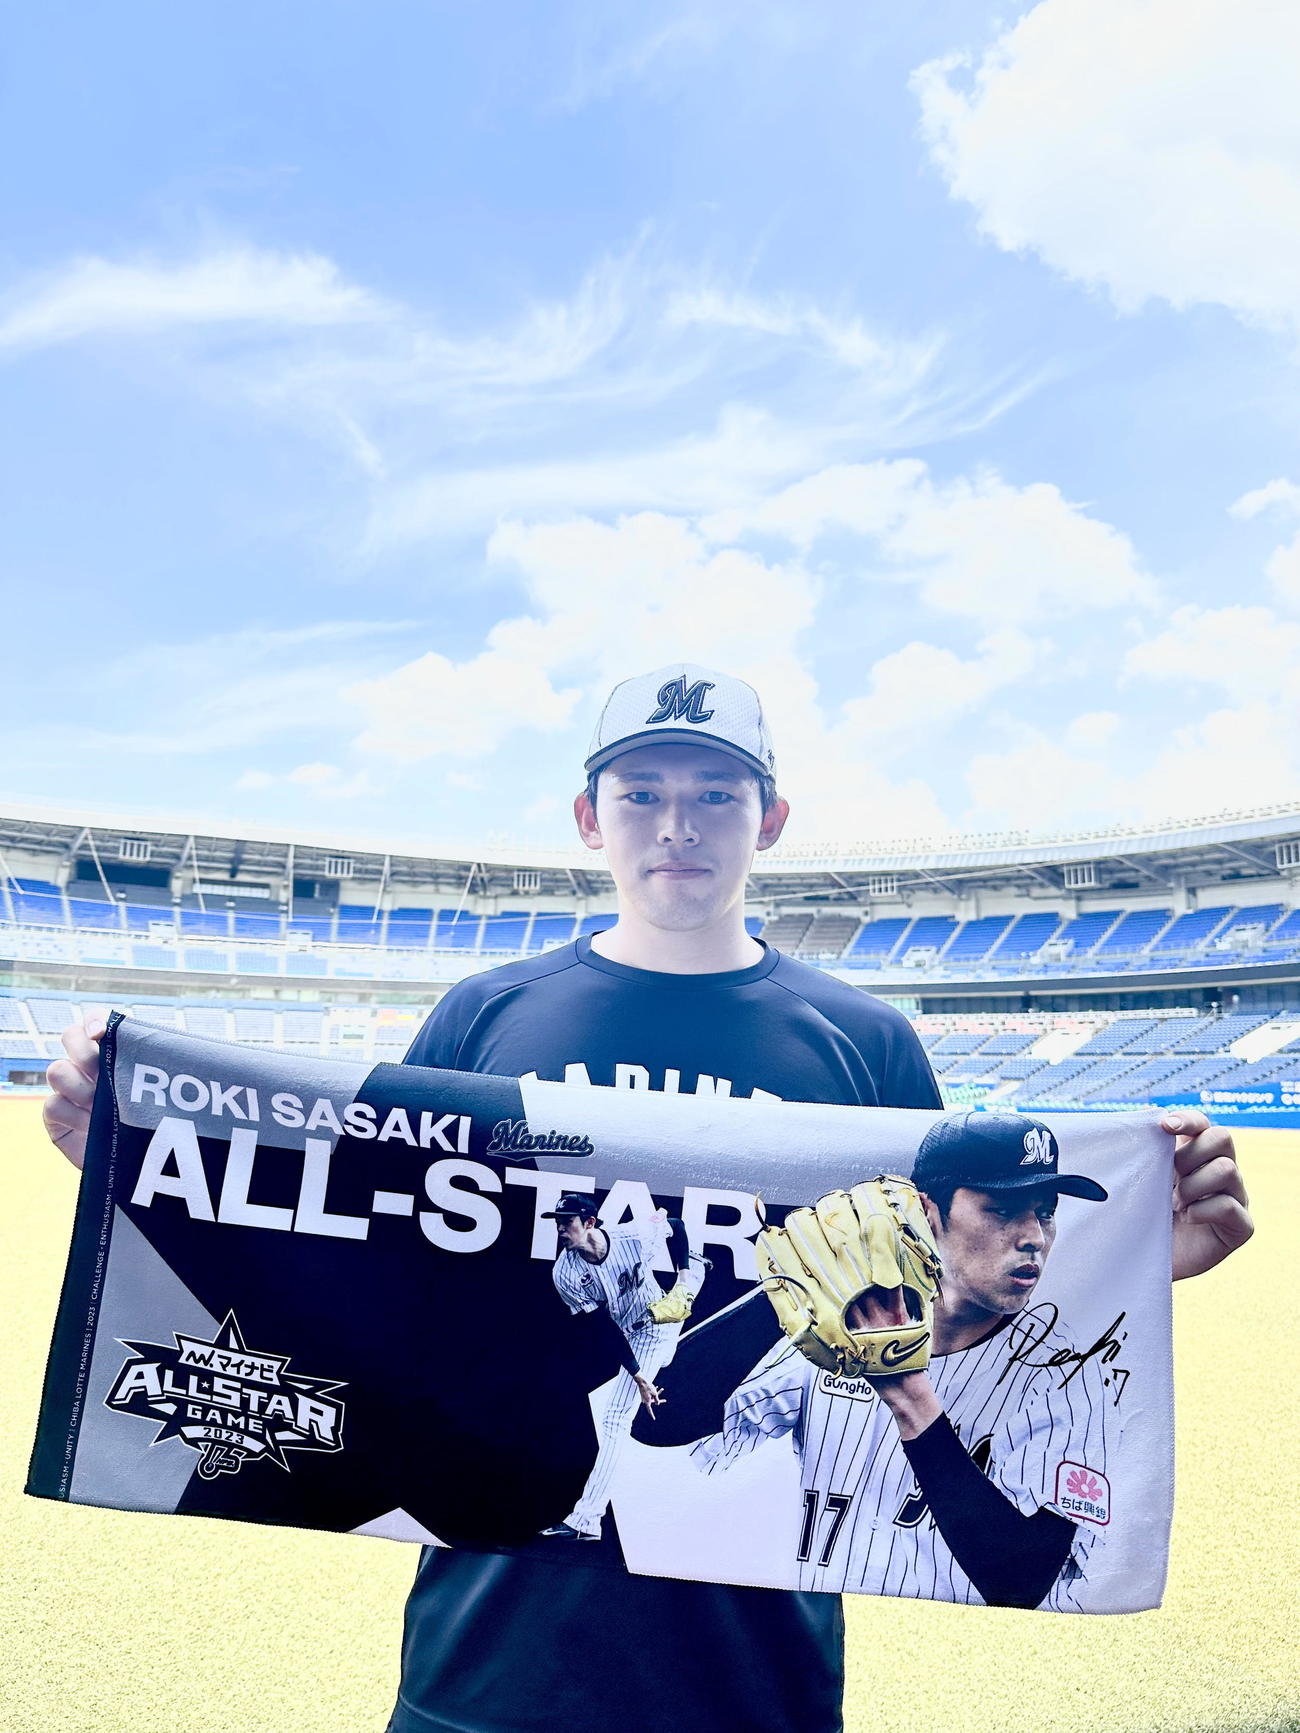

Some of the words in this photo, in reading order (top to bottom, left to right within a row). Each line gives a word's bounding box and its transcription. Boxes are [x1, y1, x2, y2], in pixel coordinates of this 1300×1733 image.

[646, 674, 716, 724] M
[131, 1063, 260, 1122] ROKI
[271, 1092, 472, 1154] SASAKI
[487, 1119, 595, 1160] Marines
[131, 1116, 768, 1282] ALL-STAR
[100, 1193, 111, 1246] ENTHUSIASM
[91, 1250, 104, 1300] CHALLENGE
[87, 1305, 95, 1327] 2023
[80, 1332, 91, 1371] MARINES
[218, 1354, 275, 1382] マイナビ
[76, 1371, 85, 1399] LOTTE
[70, 1400, 80, 1428] CHIBA
[186, 1403, 264, 1434] GAME
[65, 1433, 74, 1460] UNITY
[202, 1426, 246, 1445] 2023
[797, 1488, 854, 1568] 17
